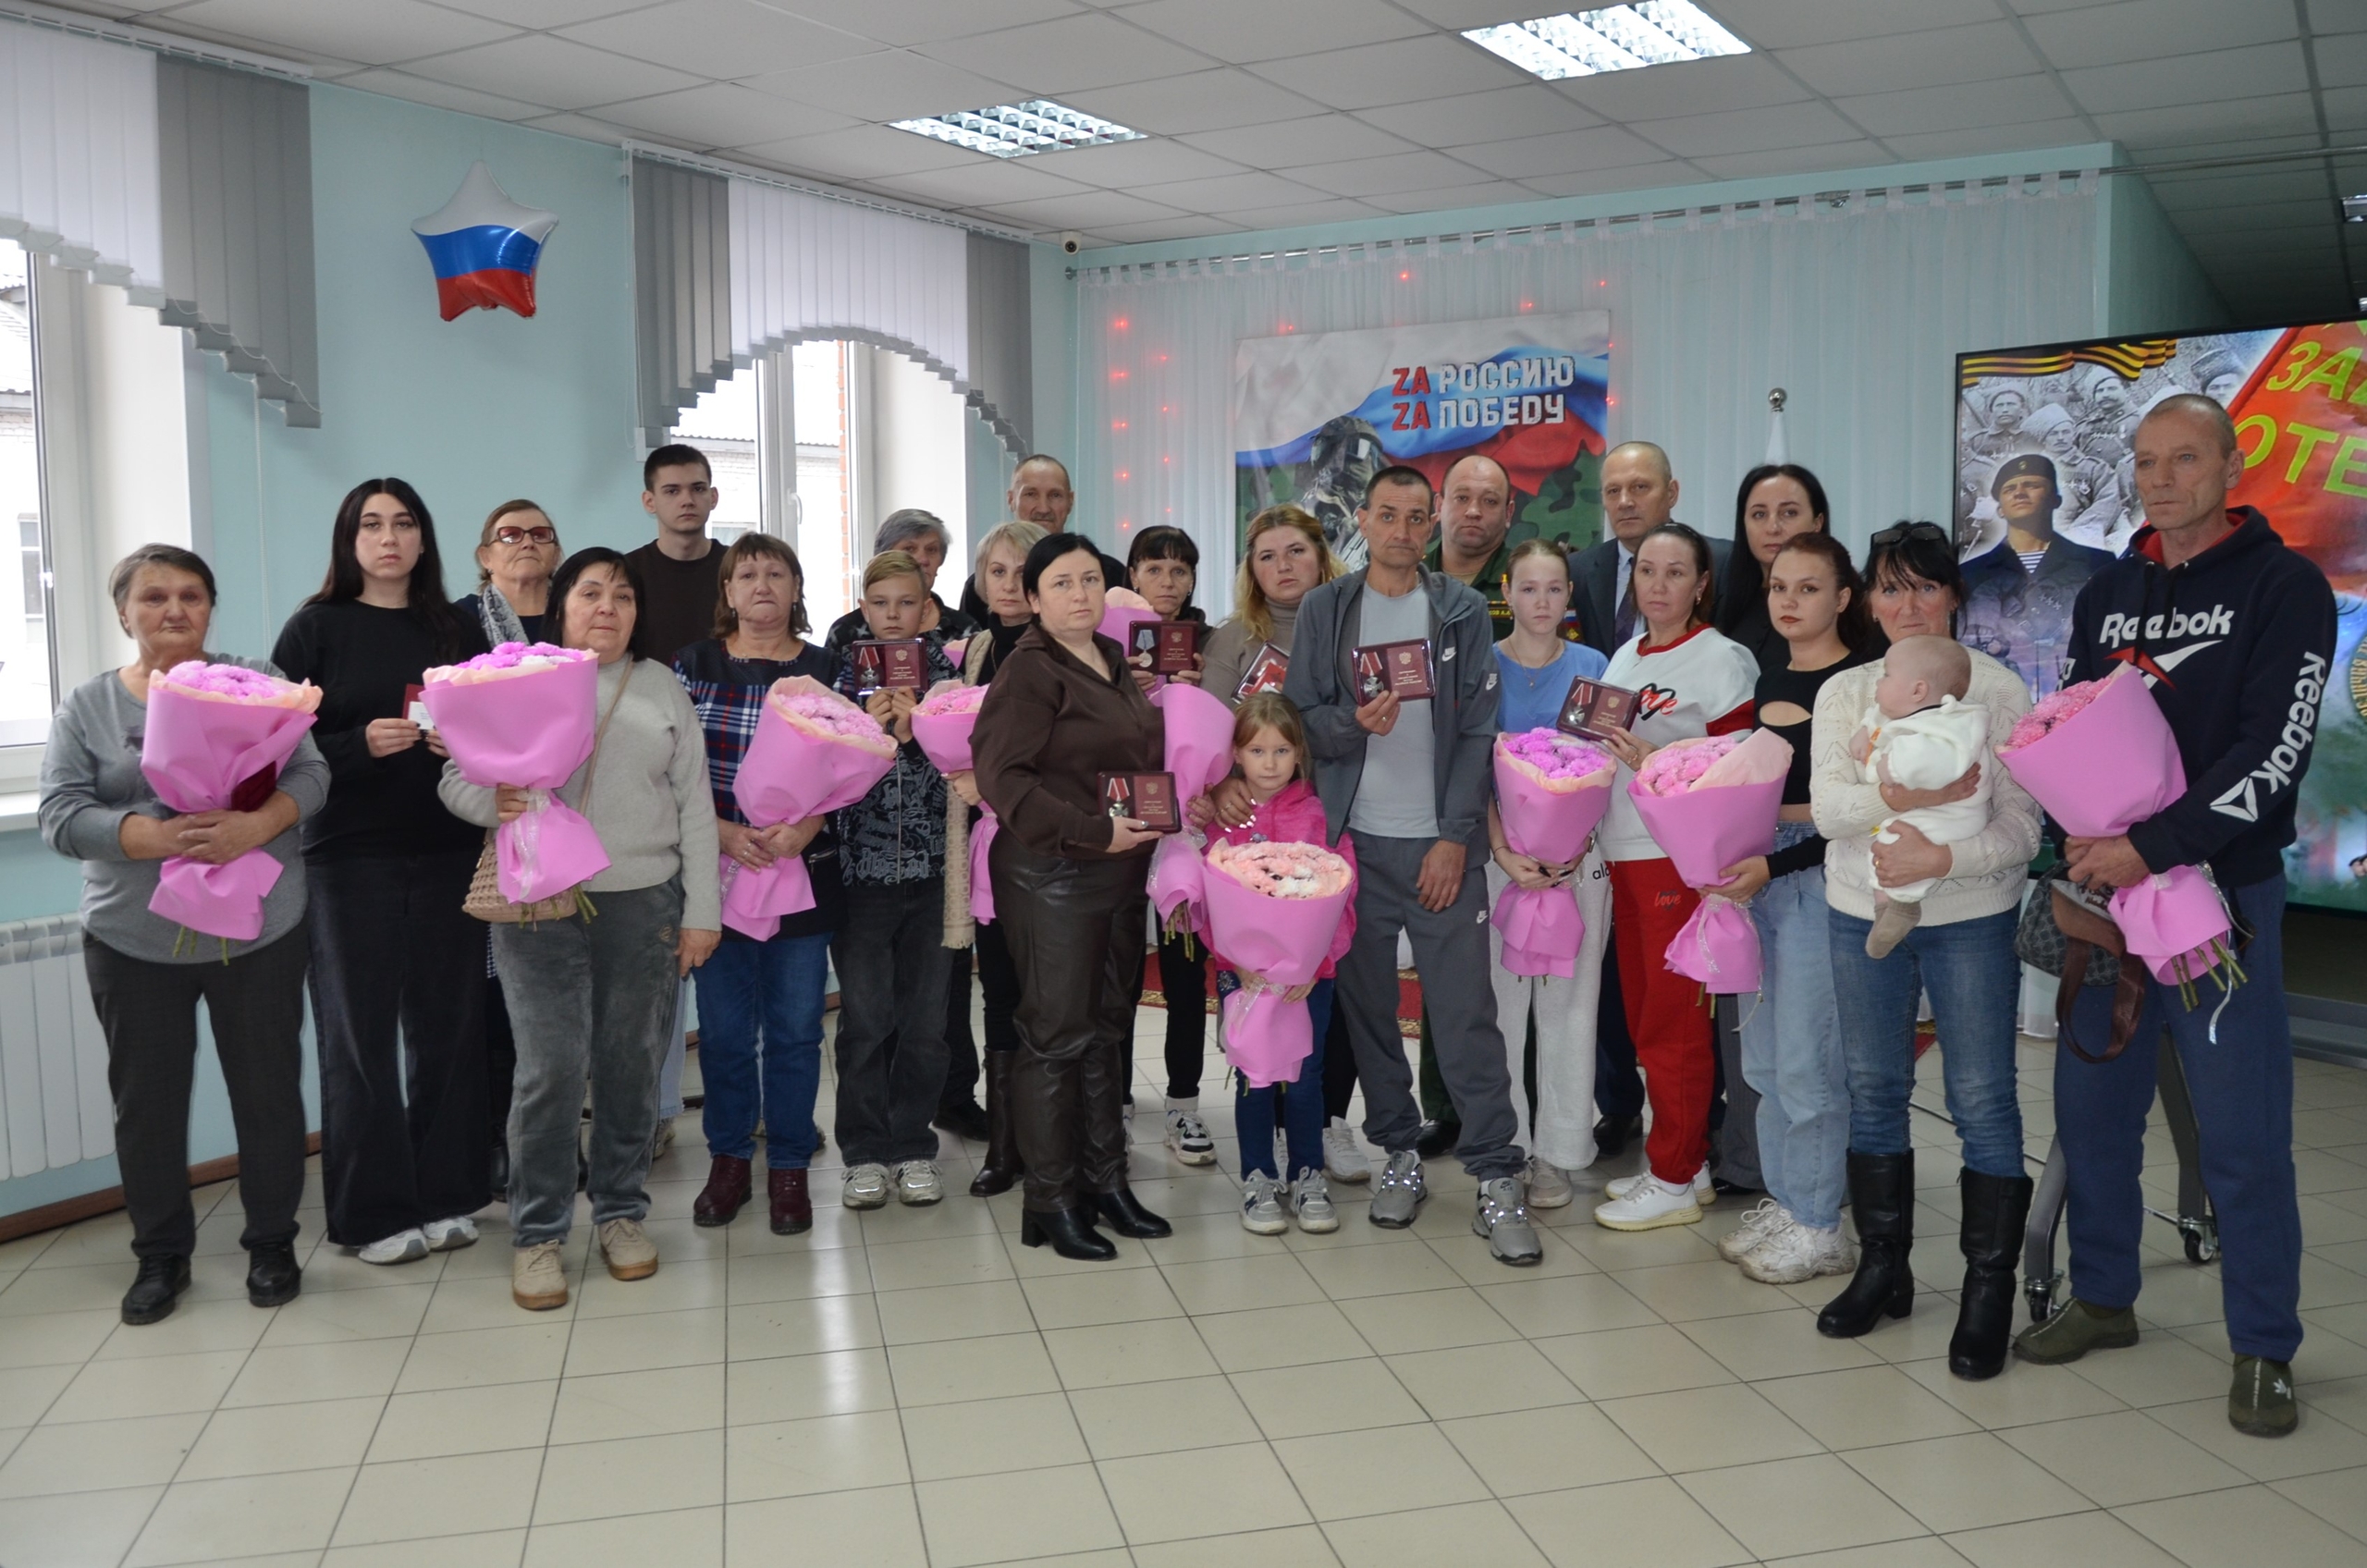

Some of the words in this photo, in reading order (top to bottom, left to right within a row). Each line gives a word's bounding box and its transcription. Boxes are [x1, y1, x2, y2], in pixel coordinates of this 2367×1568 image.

[1439, 355, 1576, 395] РОССИЮ
[2266, 341, 2367, 407] ЗА
[2099, 604, 2235, 649] Reebok
[2249, 651, 2326, 795] Reebok
[1654, 891, 1681, 907] love
